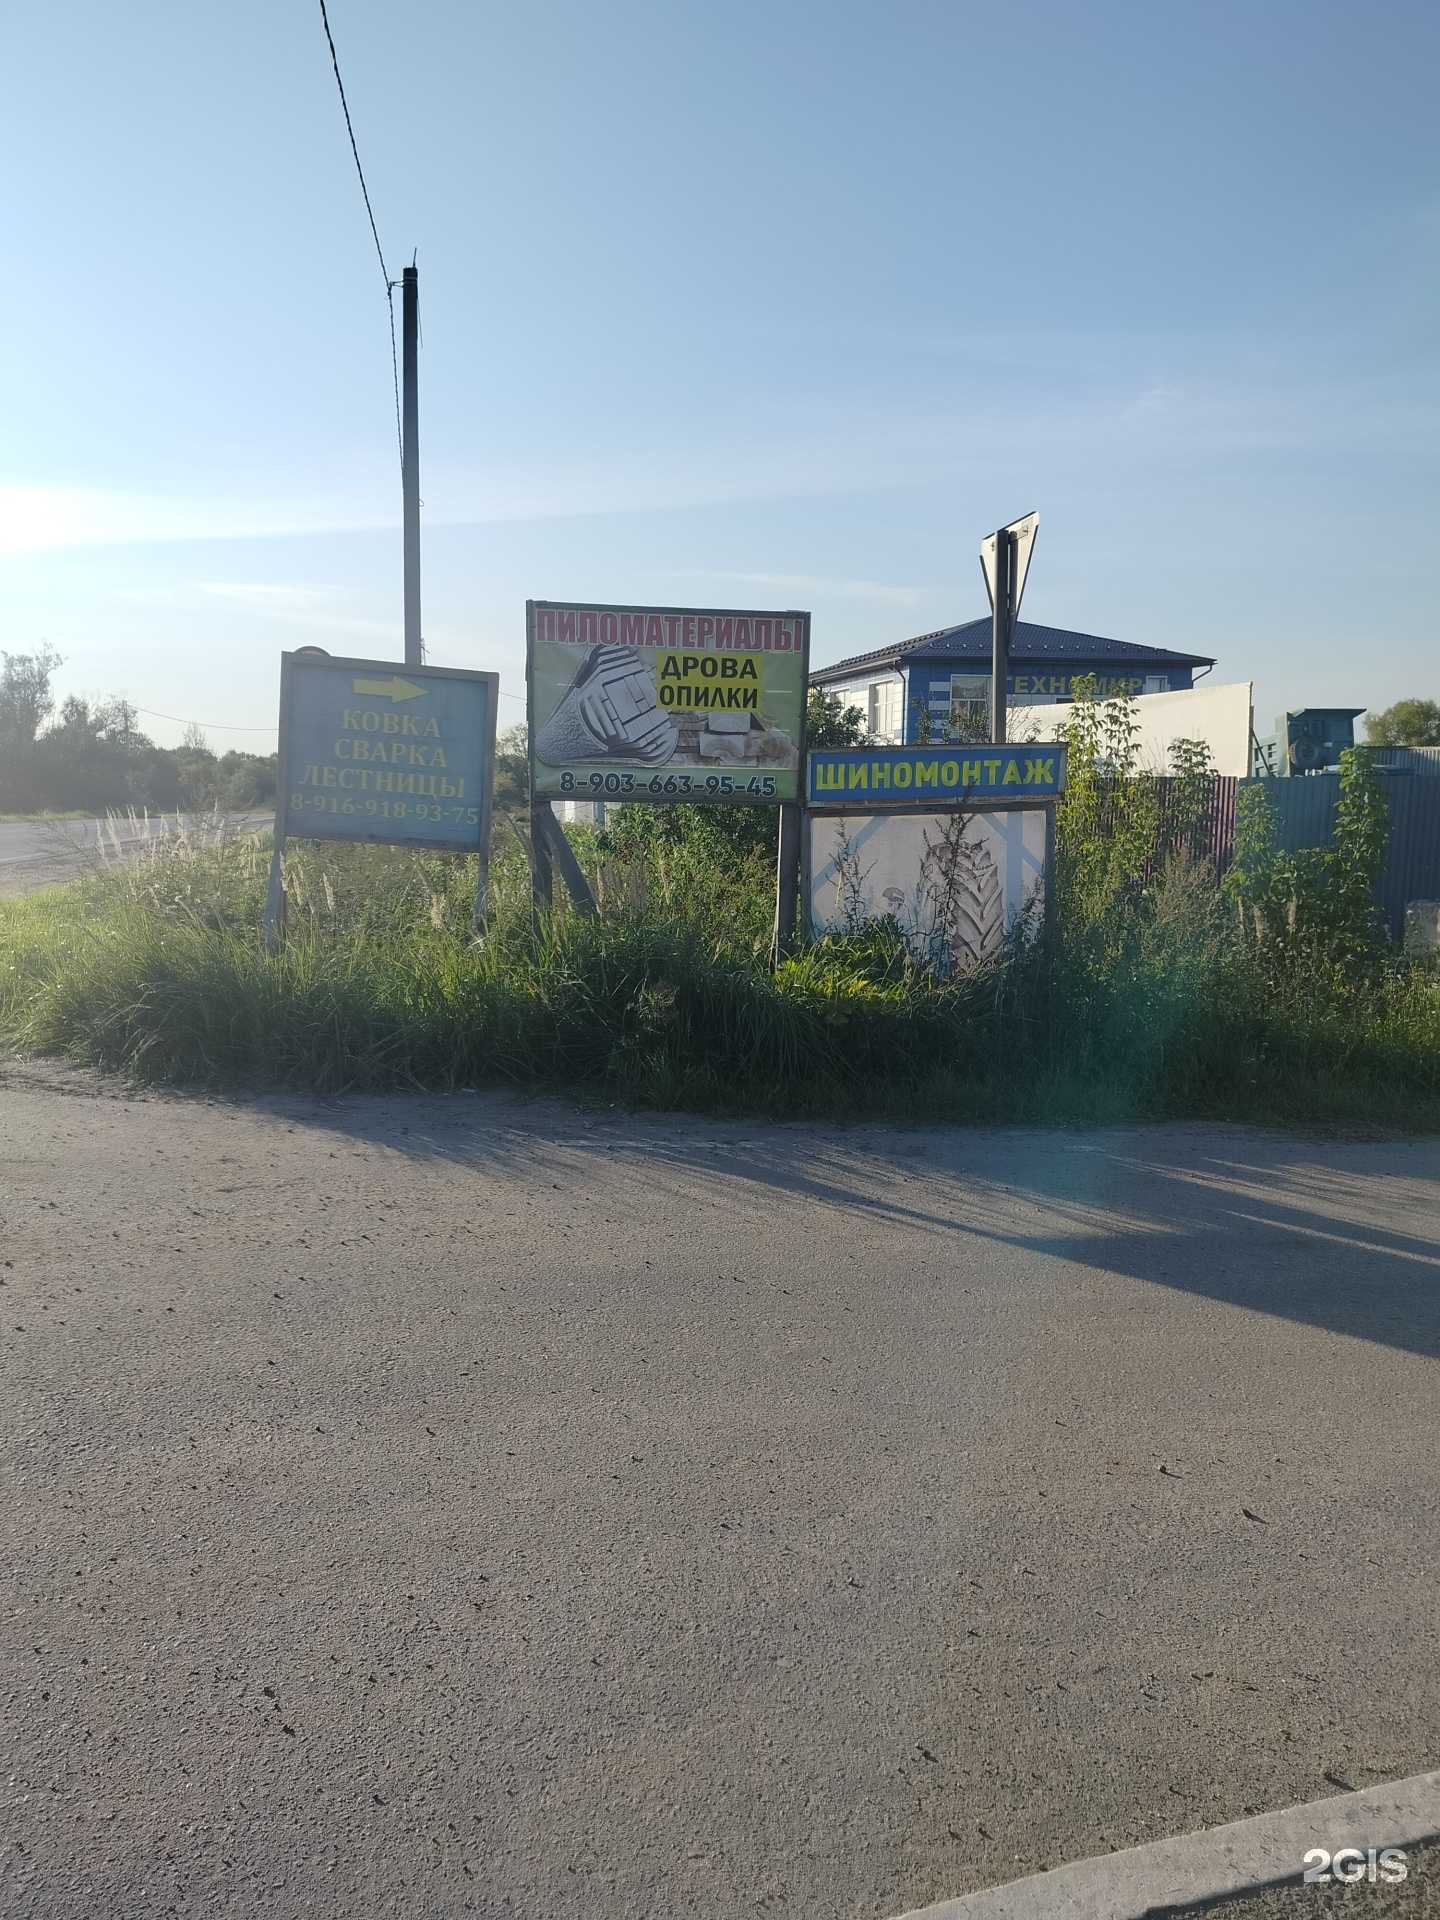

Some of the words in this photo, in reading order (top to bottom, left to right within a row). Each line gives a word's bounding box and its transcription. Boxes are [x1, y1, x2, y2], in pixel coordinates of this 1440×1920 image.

[536, 609, 804, 652] ПИЛОМАТЕРИАЛЫ
[660, 655, 758, 681] ДРОВА
[659, 685, 758, 709] ОПИЛКИ
[343, 709, 441, 738] КОВКА
[334, 738, 448, 768] СВАРКА
[298, 765, 464, 799] ЛЕСТНИЦЫ
[559, 771, 776, 798] 8-903-663-95-45
[816, 758, 1054, 791] ШИНОМОНТАЖ
[290, 793, 479, 825] 8-916-918-93-75
